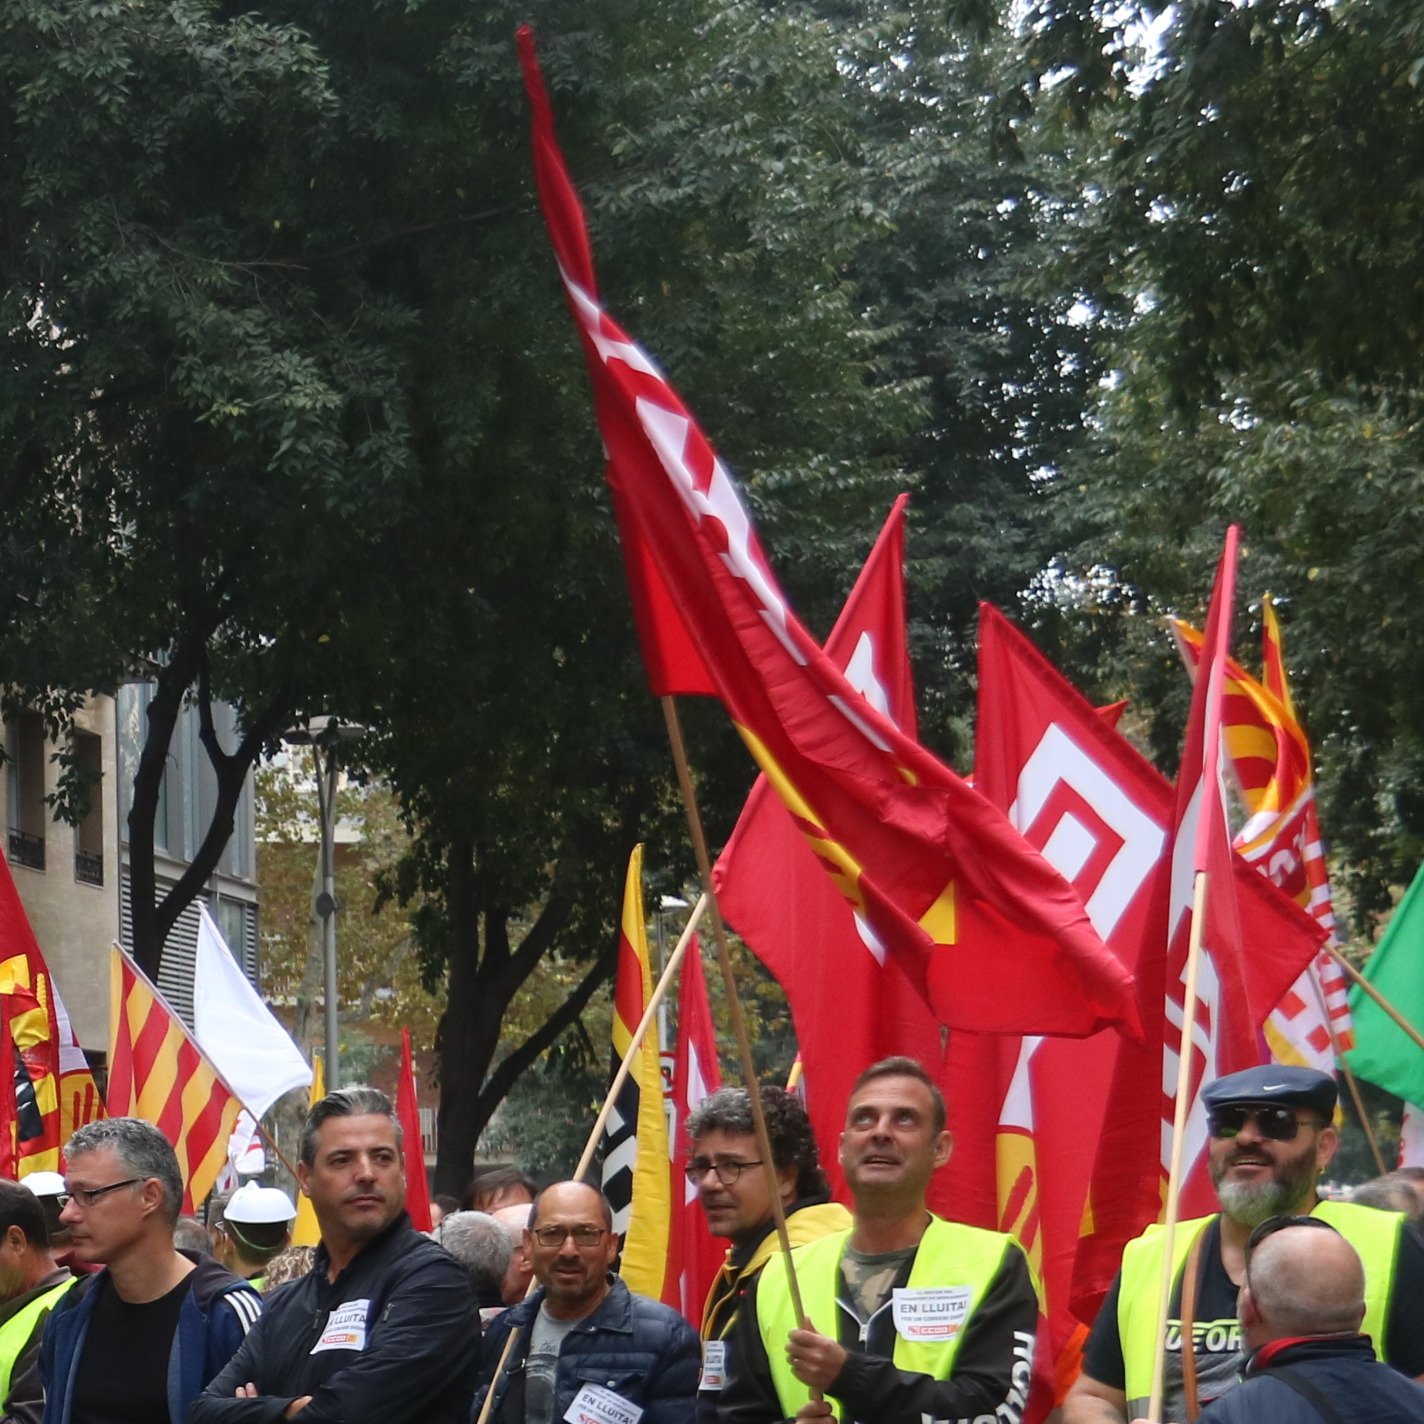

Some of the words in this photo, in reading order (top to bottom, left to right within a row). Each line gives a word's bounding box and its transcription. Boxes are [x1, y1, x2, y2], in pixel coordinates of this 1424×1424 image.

[900, 1304, 917, 1313] EN
[922, 1300, 967, 1313] LLUITA!
[581, 1394, 596, 1406] EN
